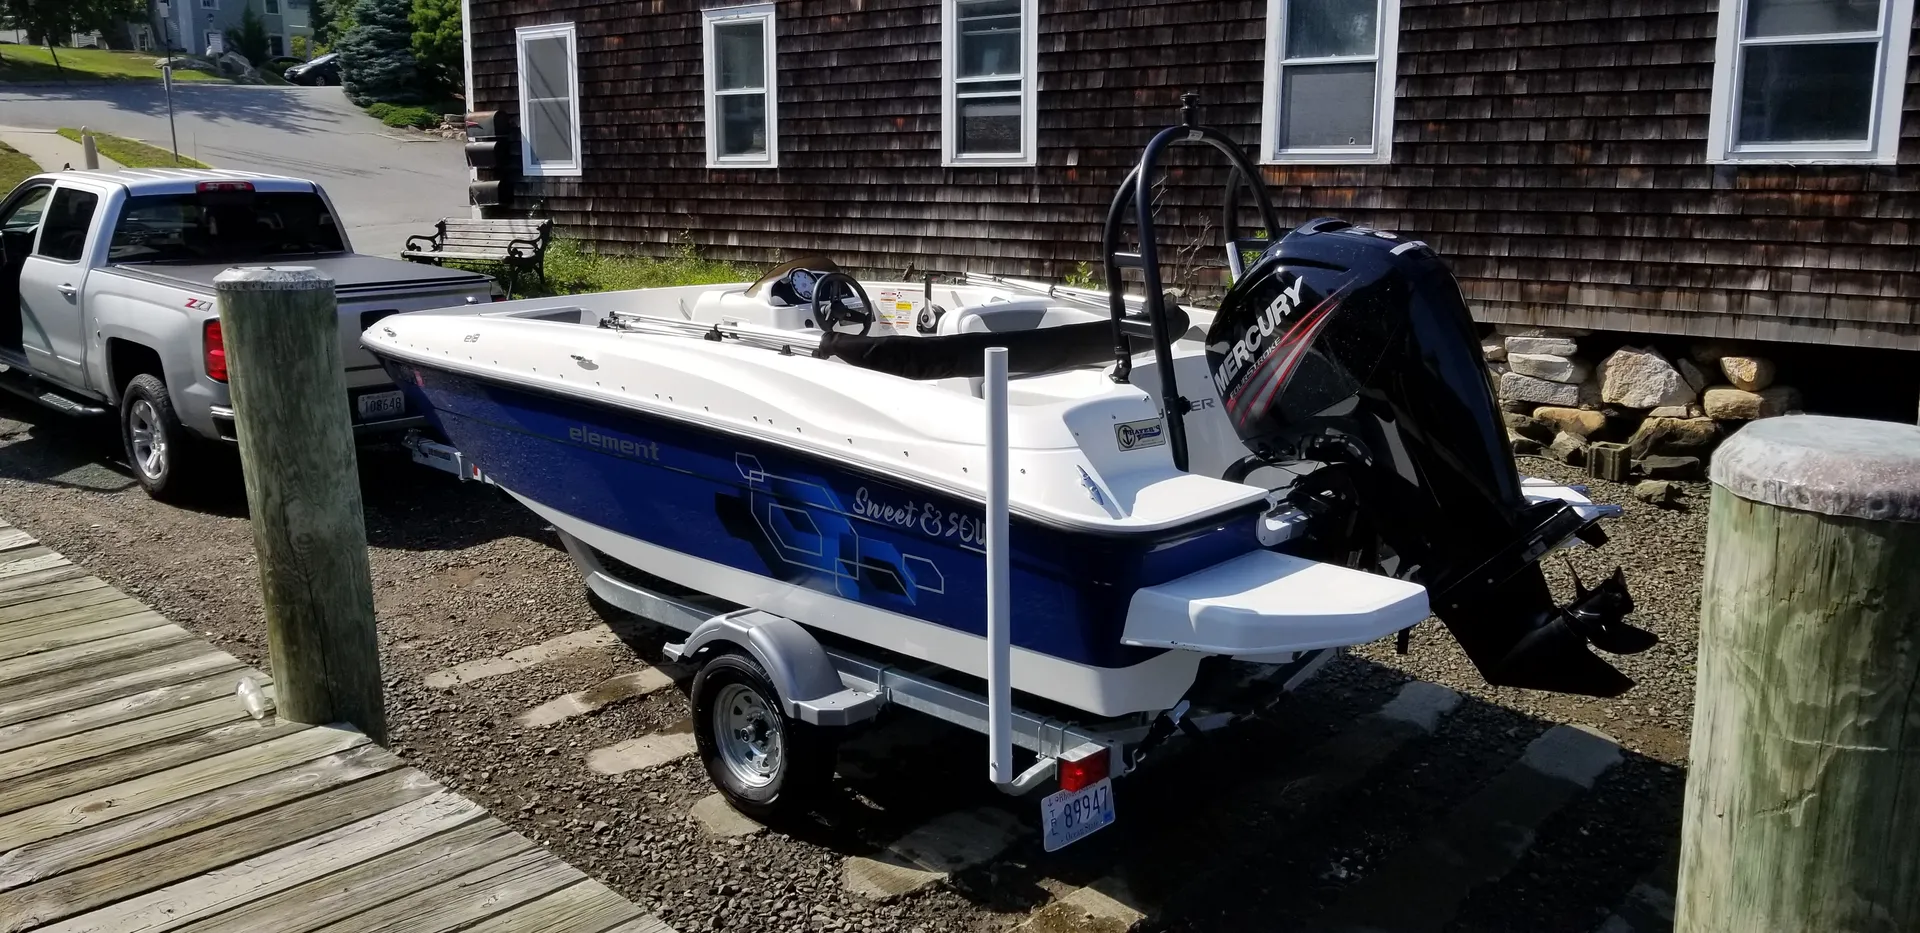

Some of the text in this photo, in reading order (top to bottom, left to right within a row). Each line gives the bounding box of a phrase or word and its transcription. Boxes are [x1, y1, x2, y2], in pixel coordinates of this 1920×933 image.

[185, 297, 213, 312] Z71
[1214, 276, 1303, 396] MERCURY
[1230, 337, 1282, 399] FOURSTROKE
[569, 426, 660, 461] element
[853, 486, 919, 528] Sweet
[920, 502, 942, 536] &
[1064, 785, 1108, 829] 89947
